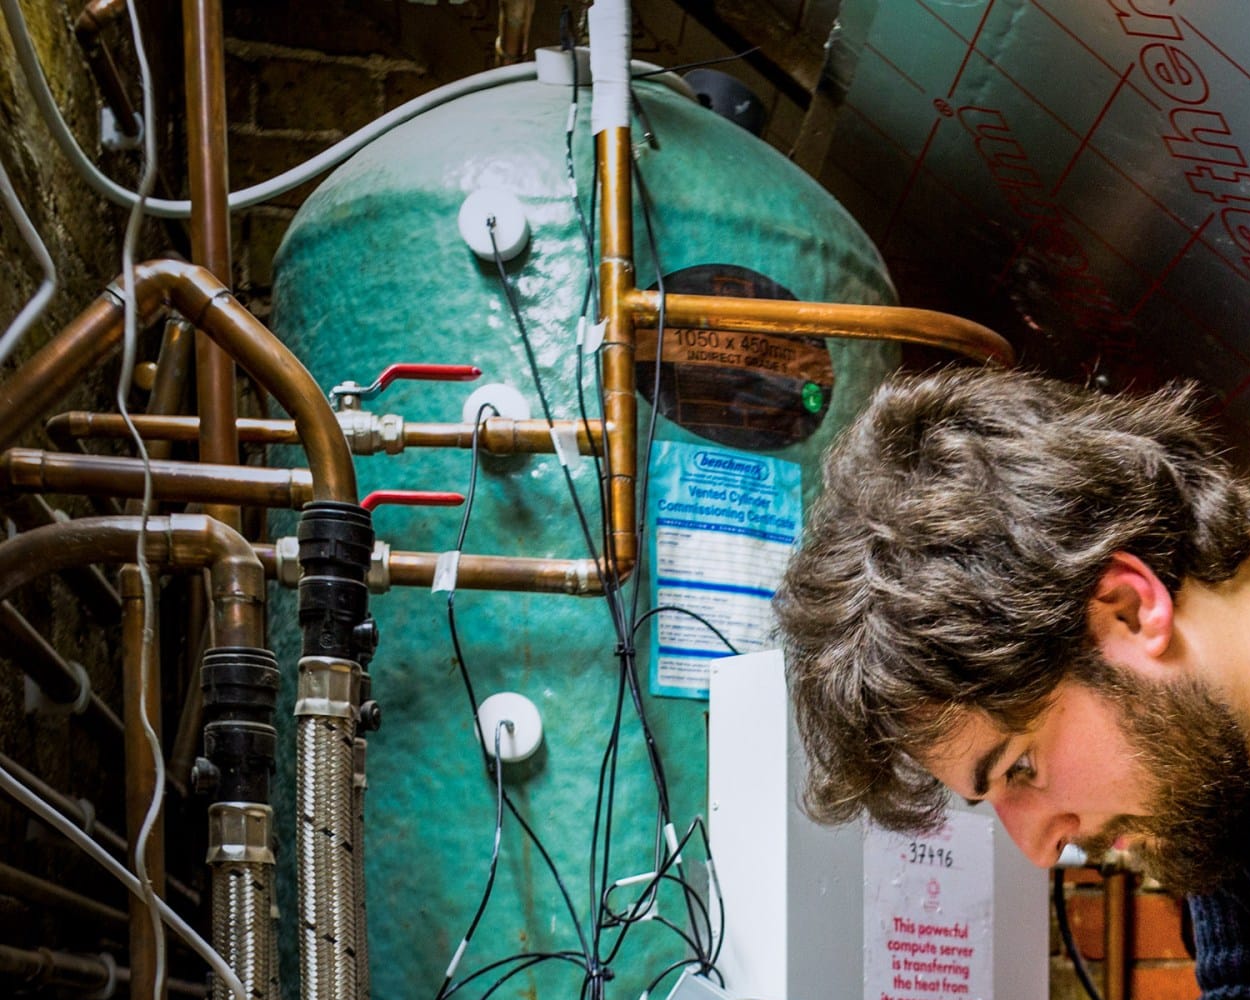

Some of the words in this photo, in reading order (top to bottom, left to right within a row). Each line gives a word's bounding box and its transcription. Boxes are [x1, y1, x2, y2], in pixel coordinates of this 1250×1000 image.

[674, 329, 719, 347] 1050
[725, 337, 735, 349] x
[740, 336, 797, 360] 450mm
[687, 350, 741, 365] INDIRECT
[699, 453, 765, 477] benchmark
[687, 485, 727, 501] Vented
[729, 490, 772, 510] Cylinder
[657, 499, 745, 522] Commissioning
[893, 917, 915, 934] This
[918, 923, 968, 939] powerful
[887, 939, 937, 956] compute
[940, 946, 974, 957] server
[891, 955, 901, 970] is
[904, 958, 970, 979] transferring
[894, 975, 912, 990] the
[915, 975, 941, 991] heat
[942, 979, 969, 993] from
